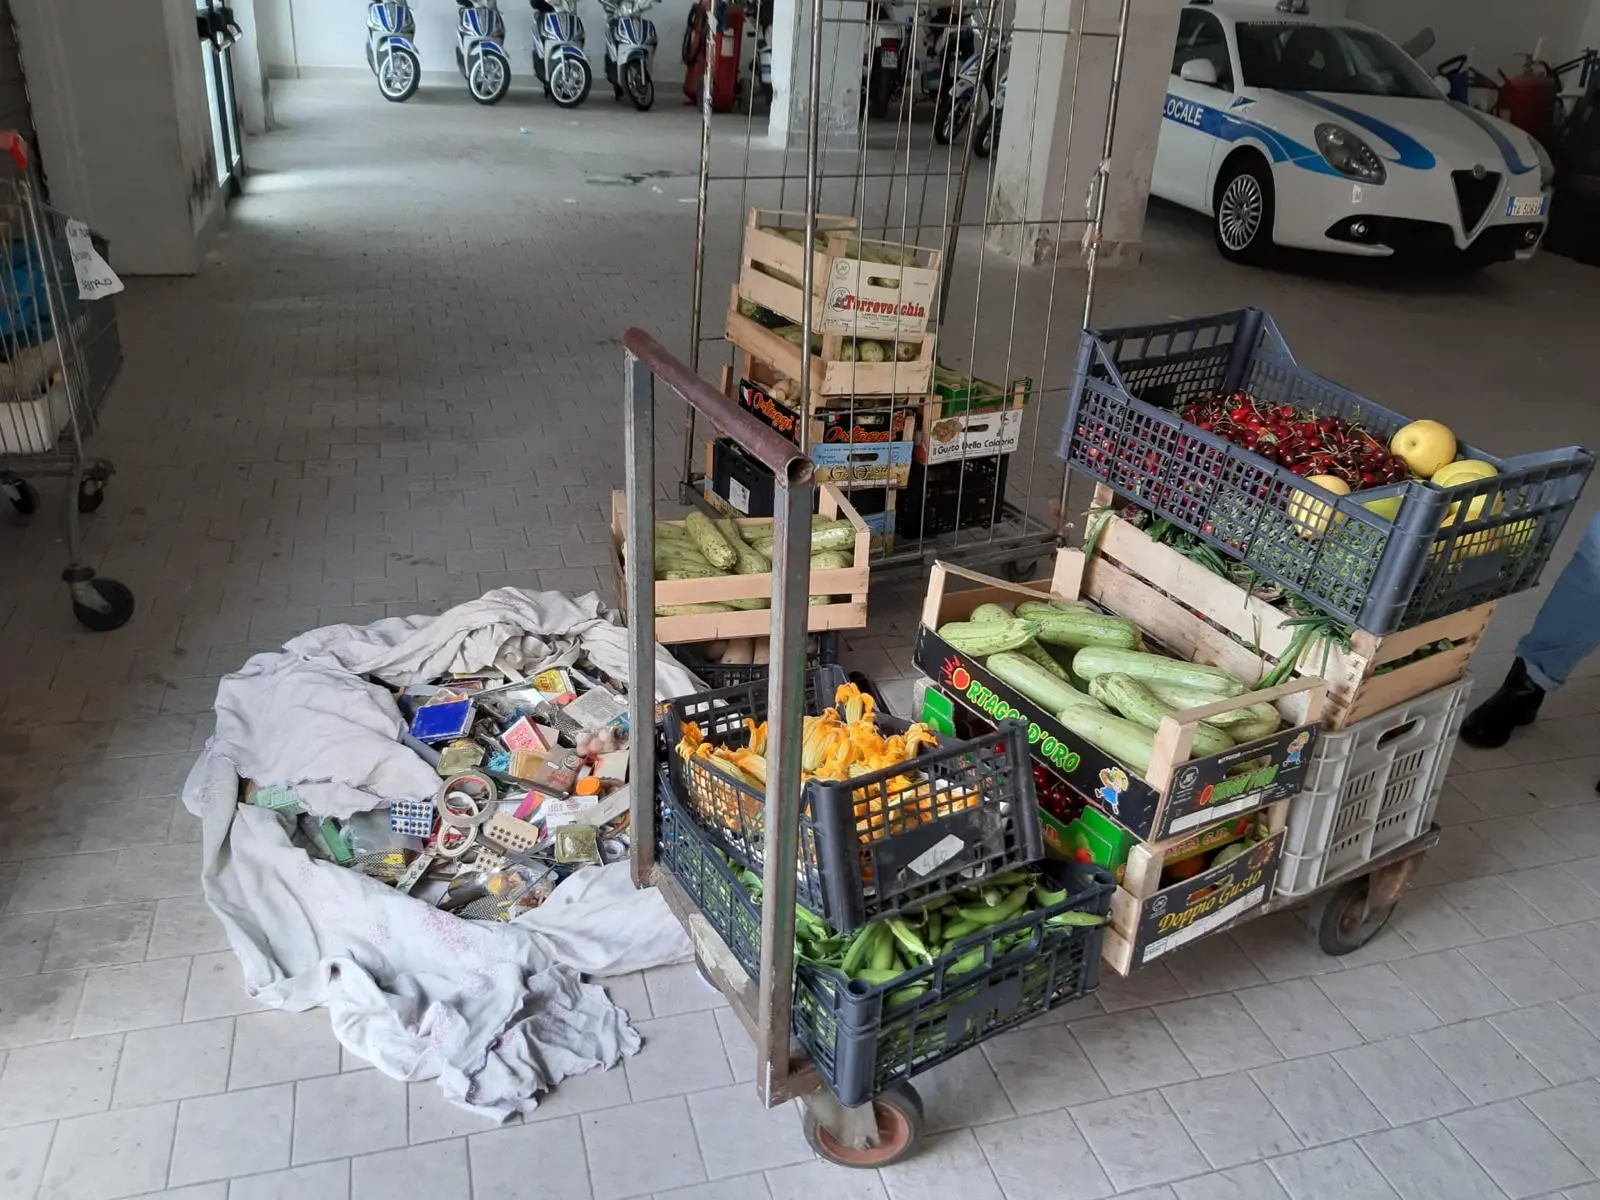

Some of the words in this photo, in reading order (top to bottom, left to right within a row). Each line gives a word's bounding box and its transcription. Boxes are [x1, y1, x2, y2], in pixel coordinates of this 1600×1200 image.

[1163, 99, 1204, 126] OCALE
[1157, 897, 1216, 934] Doppio
[1218, 869, 1263, 910] Gusto
